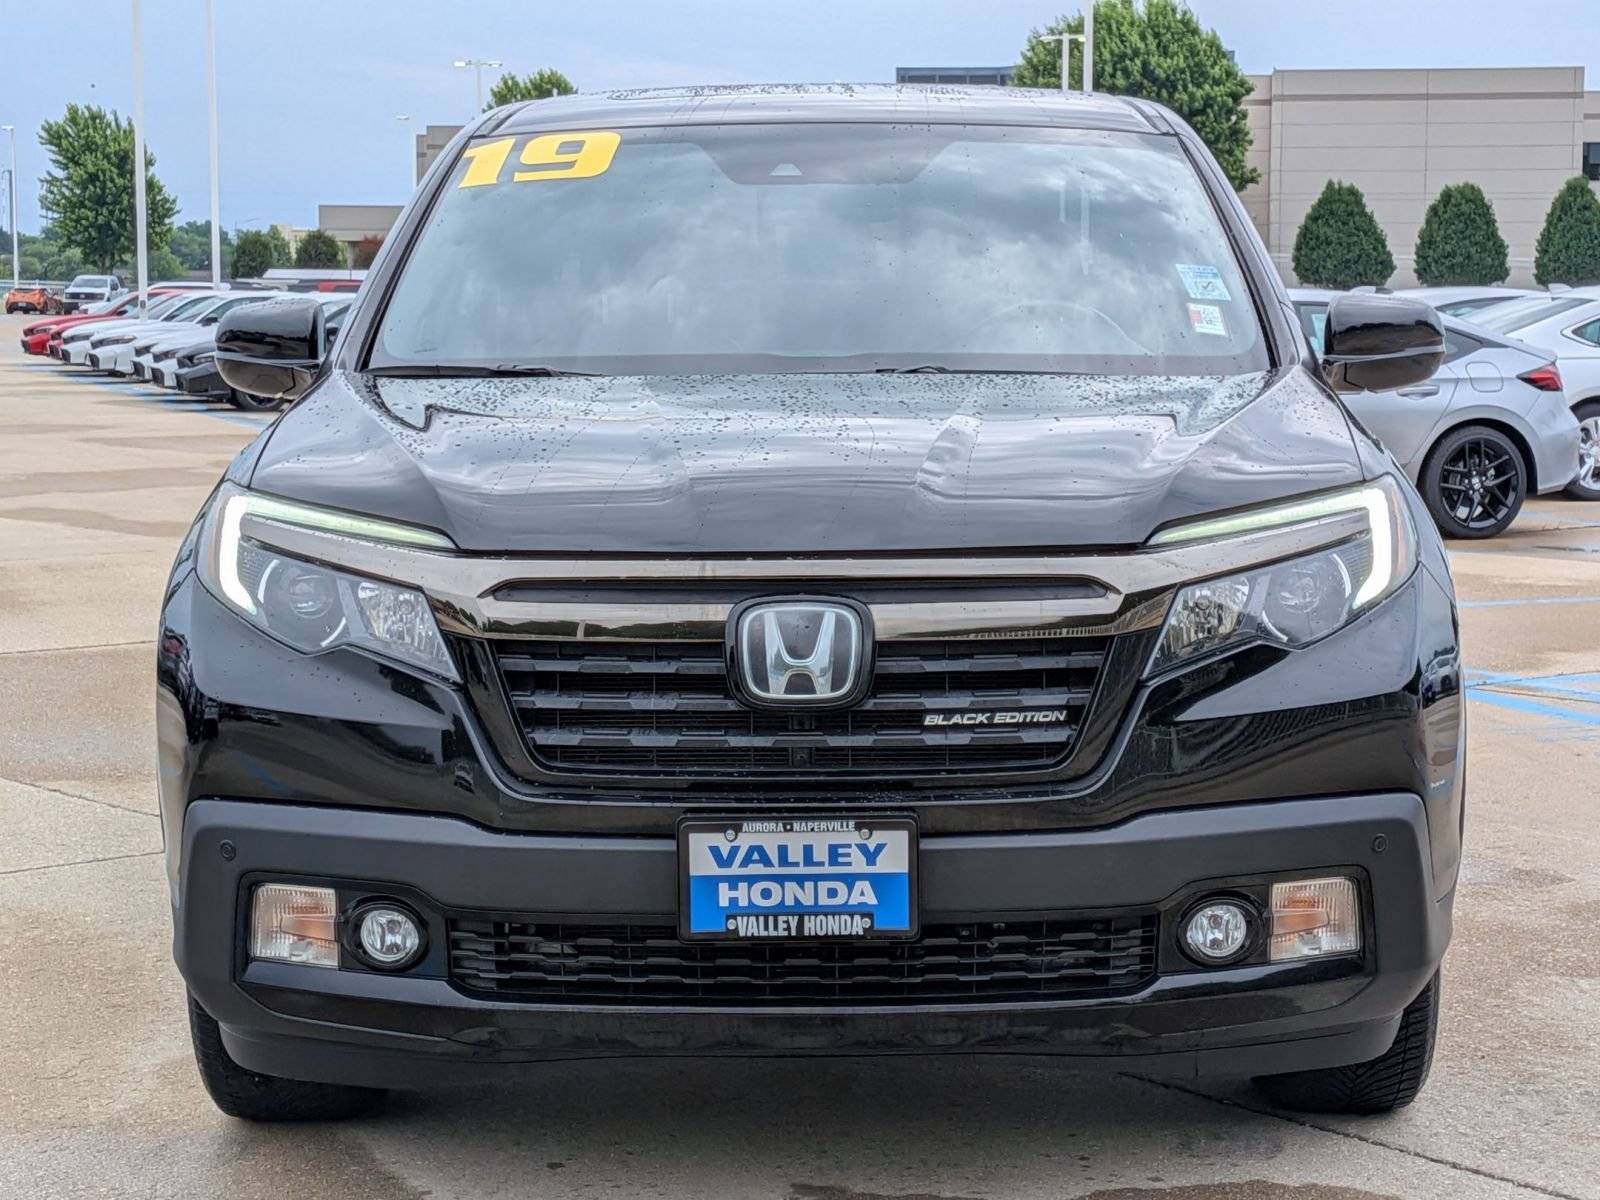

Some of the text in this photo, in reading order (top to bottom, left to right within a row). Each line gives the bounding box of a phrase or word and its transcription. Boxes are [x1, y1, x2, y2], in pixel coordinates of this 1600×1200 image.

[458, 131, 622, 189] 19
[923, 710, 1068, 726] BLACK EDITION
[742, 821, 855, 833] AURORA NAPERVILLE
[707, 843, 888, 869] VALLEY
[718, 880, 879, 907] HONDA
[736, 915, 864, 937] VALLEY HONDA
